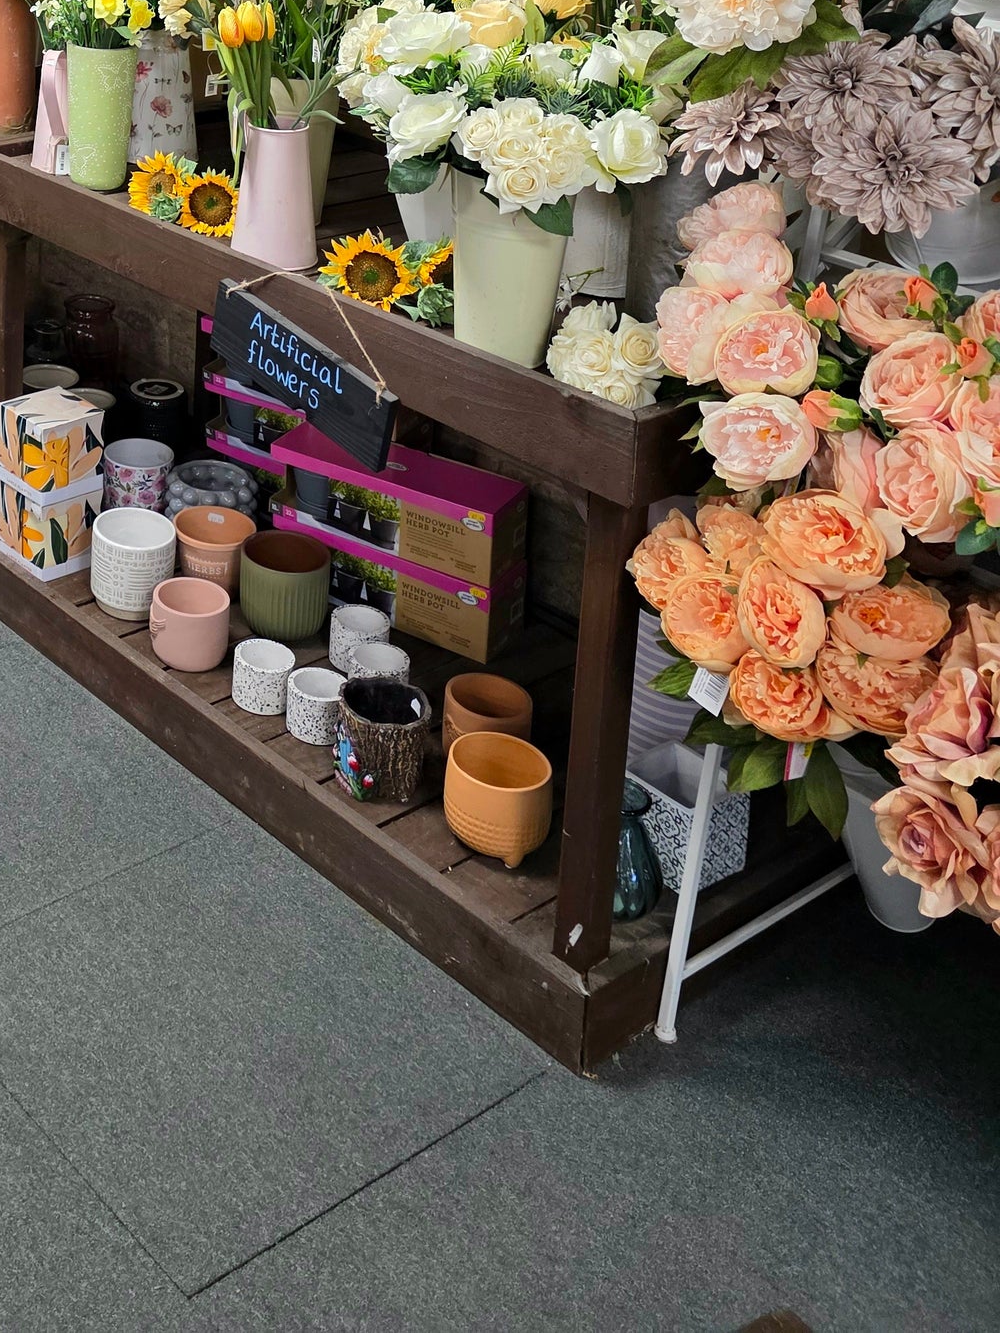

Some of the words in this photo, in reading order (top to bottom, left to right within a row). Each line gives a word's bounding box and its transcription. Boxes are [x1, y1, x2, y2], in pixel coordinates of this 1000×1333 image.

[249, 311, 343, 395] Artificial
[247, 339, 320, 409] flowers
[406, 510, 466, 536] WINDOWSILL
[406, 518, 429, 531] HERB
[432, 526, 450, 538] POT
[401, 589, 425, 604] HERB
[427, 600, 445, 611] POT
[402, 581, 460, 610] WINDOWSILL
